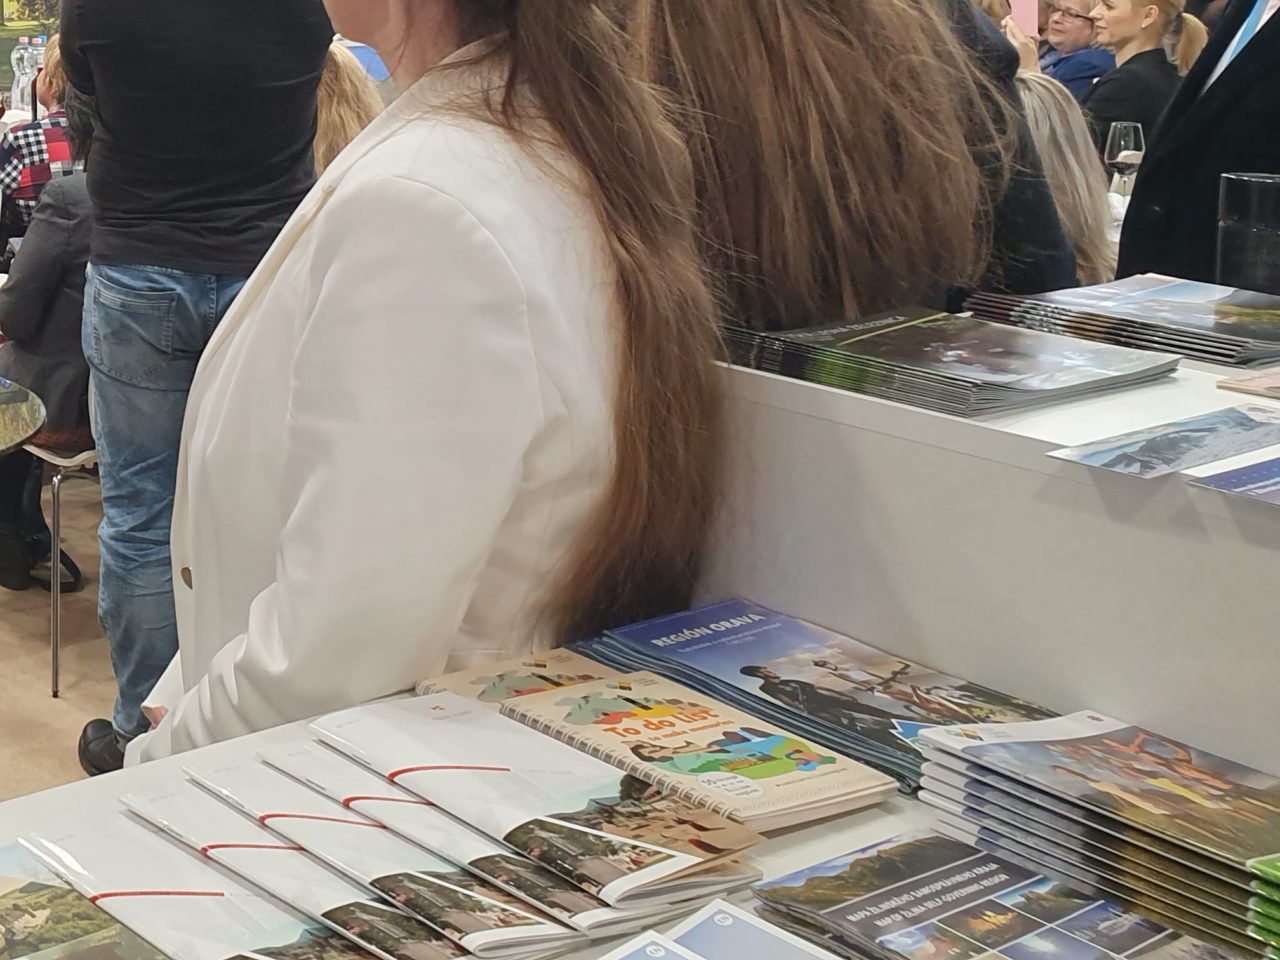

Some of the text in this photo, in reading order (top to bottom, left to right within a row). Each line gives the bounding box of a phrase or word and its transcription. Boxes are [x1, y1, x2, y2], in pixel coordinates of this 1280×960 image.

[650, 628, 713, 647] REGIÓN
[709, 613, 767, 632] ORAVA
[602, 726, 641, 738] To
[642, 718, 676, 731] do
